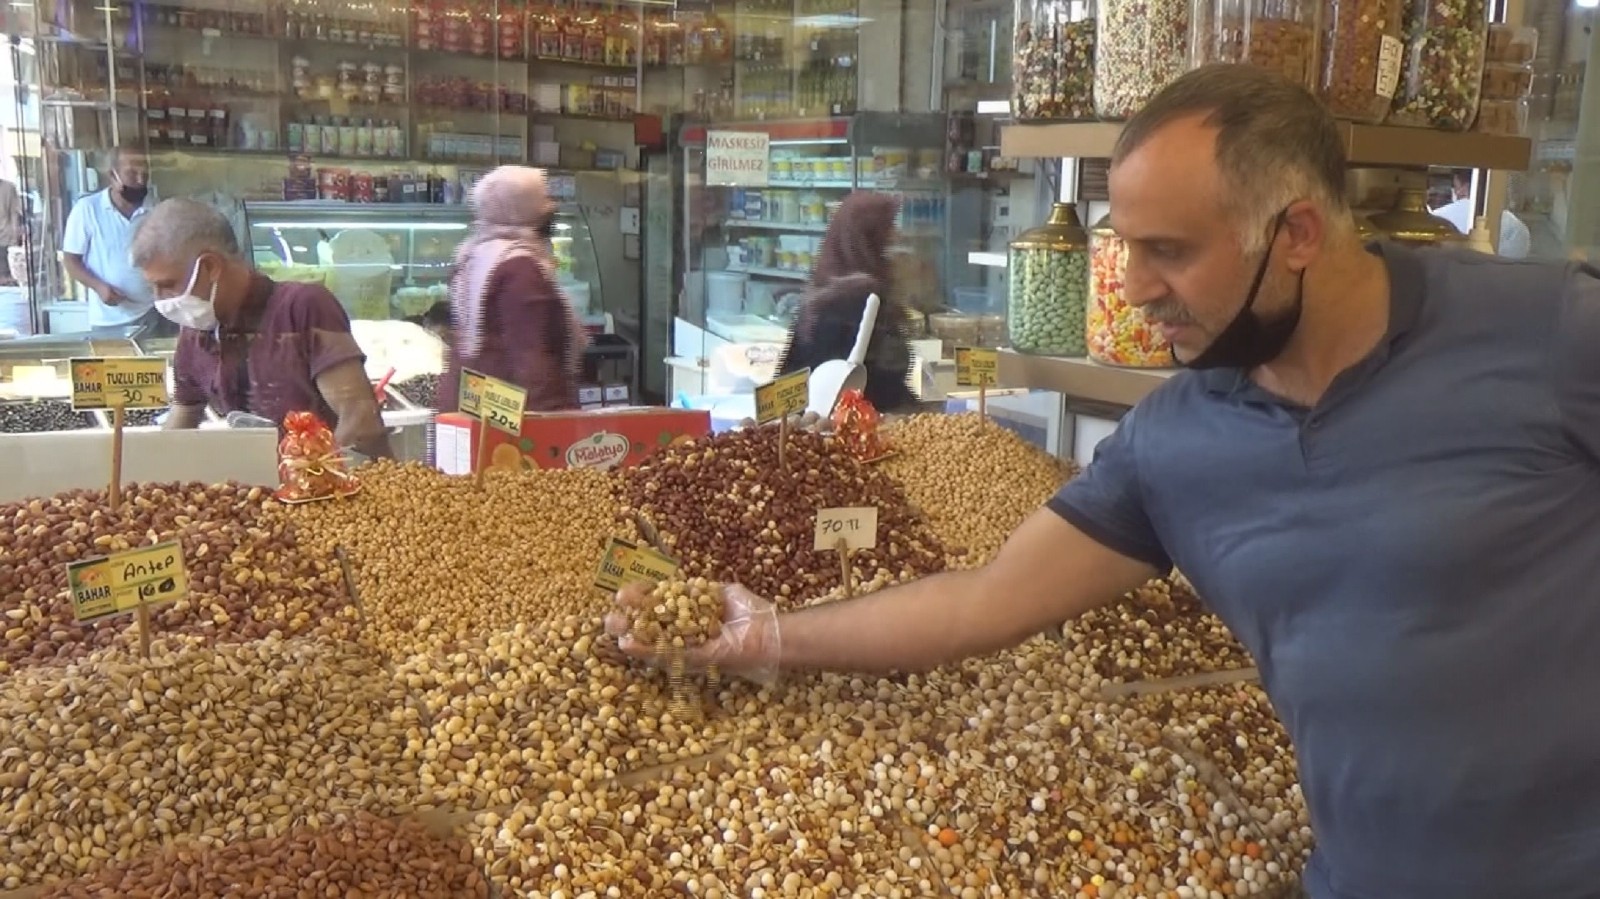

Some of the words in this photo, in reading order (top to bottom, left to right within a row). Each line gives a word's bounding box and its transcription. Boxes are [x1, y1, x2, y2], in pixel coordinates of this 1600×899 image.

[708, 135, 766, 149] MASKESİZ
[708, 155, 763, 171] GİRİLMEZ
[106, 372, 135, 385] TUZLU
[136, 371, 165, 384] FISTIK
[74, 382, 103, 393] BAHAR
[123, 388, 143, 403] 30
[573, 443, 624, 464] Malatya
[821, 518, 843, 535] 70
[78, 585, 112, 604] BAHAR
